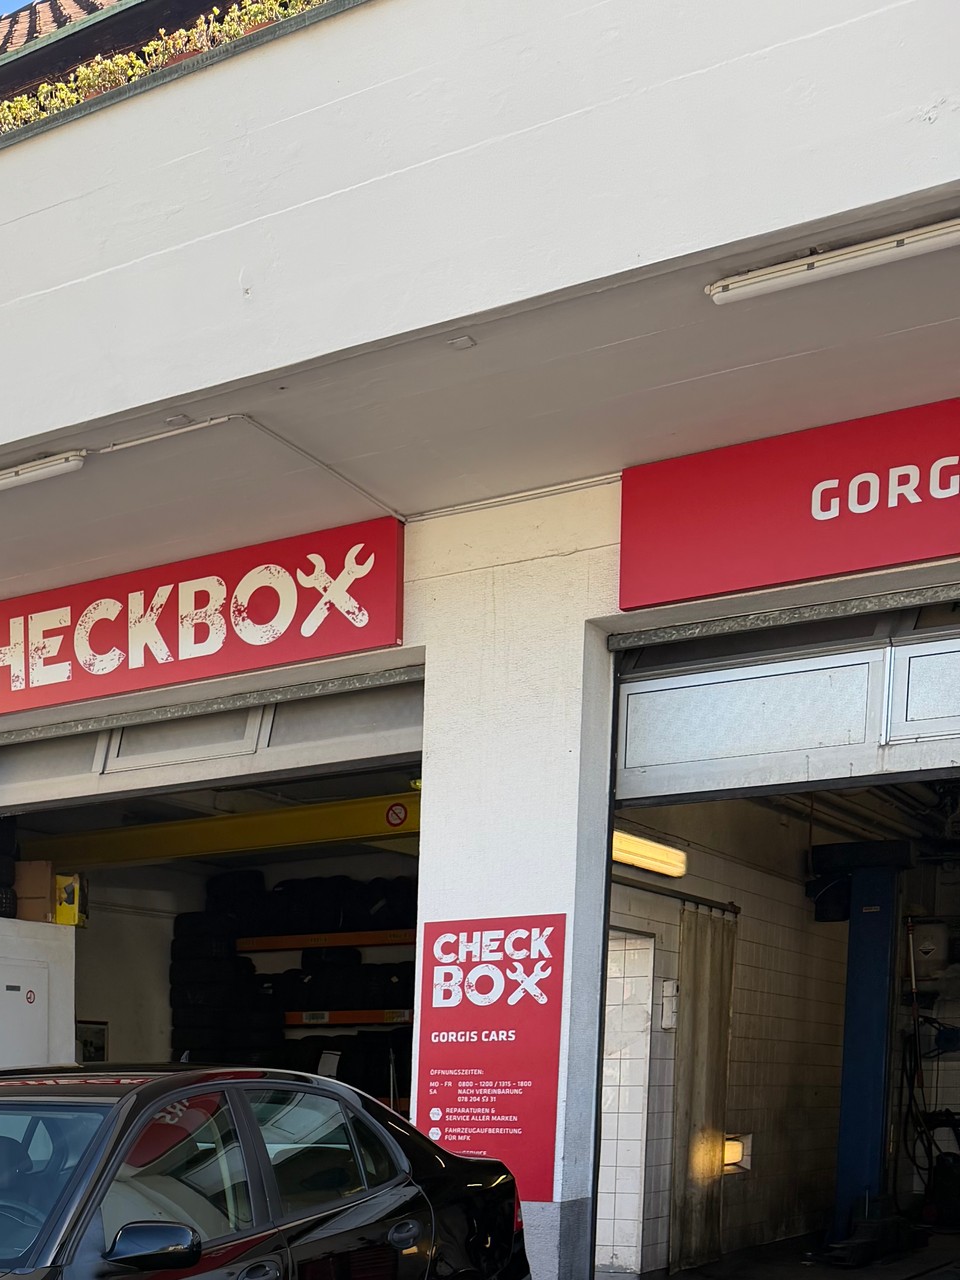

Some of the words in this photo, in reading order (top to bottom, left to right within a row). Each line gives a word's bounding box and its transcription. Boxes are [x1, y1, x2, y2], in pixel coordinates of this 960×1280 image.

[810, 455, 960, 521] GORG
[433, 926, 555, 963] CHECK
[432, 960, 552, 1008] BOX
[431, 1031, 478, 1043] GORGIS
[481, 1029, 516, 1042] CARS
[429, 1068, 484, 1076] ÖFFNUNGSZEITEN:
